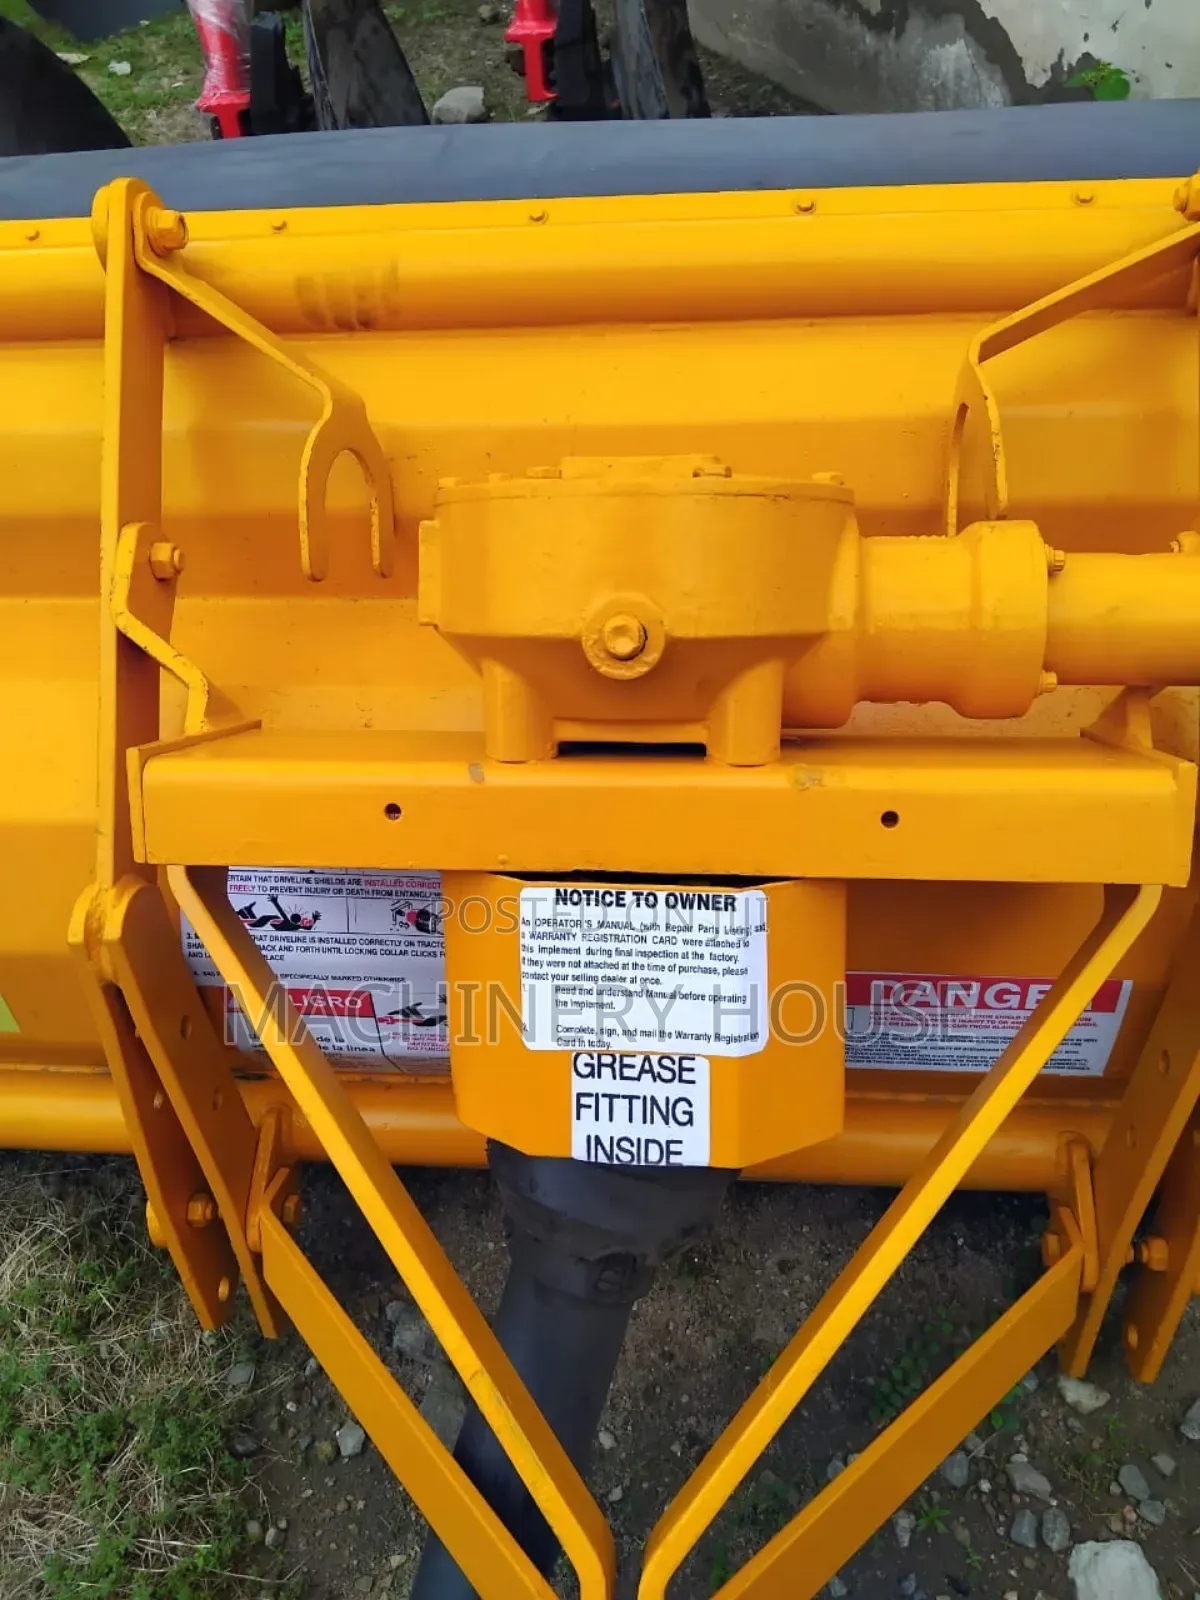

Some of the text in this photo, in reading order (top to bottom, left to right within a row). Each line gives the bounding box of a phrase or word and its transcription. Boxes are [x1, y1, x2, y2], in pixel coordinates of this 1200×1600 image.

[254, 875, 272, 883] THAT
[274, 875, 312, 885] DRIVELINE
[347, 878, 362, 886] ARE
[229, 884, 255, 892] FREELY
[304, 887, 330, 895] INJURY
[332, 887, 344, 895] OR
[345, 888, 370, 896] DEATH
[371, 889, 394, 897] FROM
[555, 888, 737, 912] NOTICE TO OWNER
[597, 920, 636, 931] MANUAL
[665, 922, 693, 934] Repair
[698, 923, 719, 934] Parts
[269, 935, 307, 944] DRIVELINE
[317, 937, 357, 946] INSTALLED
[358, 938, 402, 947] CORRECTLY
[529, 931, 577, 941] WARRANTY
[581, 932, 648, 944] REGISTRATION
[652, 935, 678, 946] CARD
[682, 939, 703, 947] were
[278, 945, 295, 953] AND
[296, 945, 321, 954] FORTH
[321, 947, 343, 955] UNTIL
[344, 947, 378, 957] LOCKING
[379, 948, 409, 957] COLLAR
[410, 949, 438, 959] CLICKS
[585, 945, 613, 958] during
[614, 946, 633, 957] final
[634, 948, 679, 960] inspection
[681, 950, 689, 960] at
[691, 951, 705, 961] the
[709, 952, 740, 964] factory.
[527, 957, 543, 969] they
[546, 959, 565, 968] were
[568, 959, 581, 968] not
[583, 960, 619, 970] attached
[621, 961, 629, 970] at
[631, 961, 646, 971] the
[647, 963, 666, 972] time
[668, 964, 677, 972] of
[678, 965, 720, 976] purchase,
[722, 966, 749, 977] please
[550, 973, 569, 983] your
[571, 974, 599, 985] selling
[600, 975, 627, 984] dealer
[629, 975, 637, 984] at
[554, 985, 577, 995] Read
[578, 986, 593, 996] and
[596, 987, 643, 998] understand
[645, 989, 677, 1000] Manual
[679, 991, 706, 1001] before
[708, 993, 747, 1005] operating
[555, 998, 568, 1008] the
[870, 980, 1053, 1010] DANGE
[556, 1024, 598, 1036] Complete,
[600, 1027, 619, 1037] sign,
[622, 1028, 637, 1038] and
[639, 1029, 657, 1038] mail
[659, 1029, 672, 1039] the
[674, 1030, 712, 1043] Warranty
[714, 1031, 760, 1045] Registration
[556, 1037, 613, 1050] Card in today.
[573, 1052, 696, 1085] GREASE
[576, 1092, 694, 1127] FITTING
[586, 1134, 684, 1166] INSIDE
